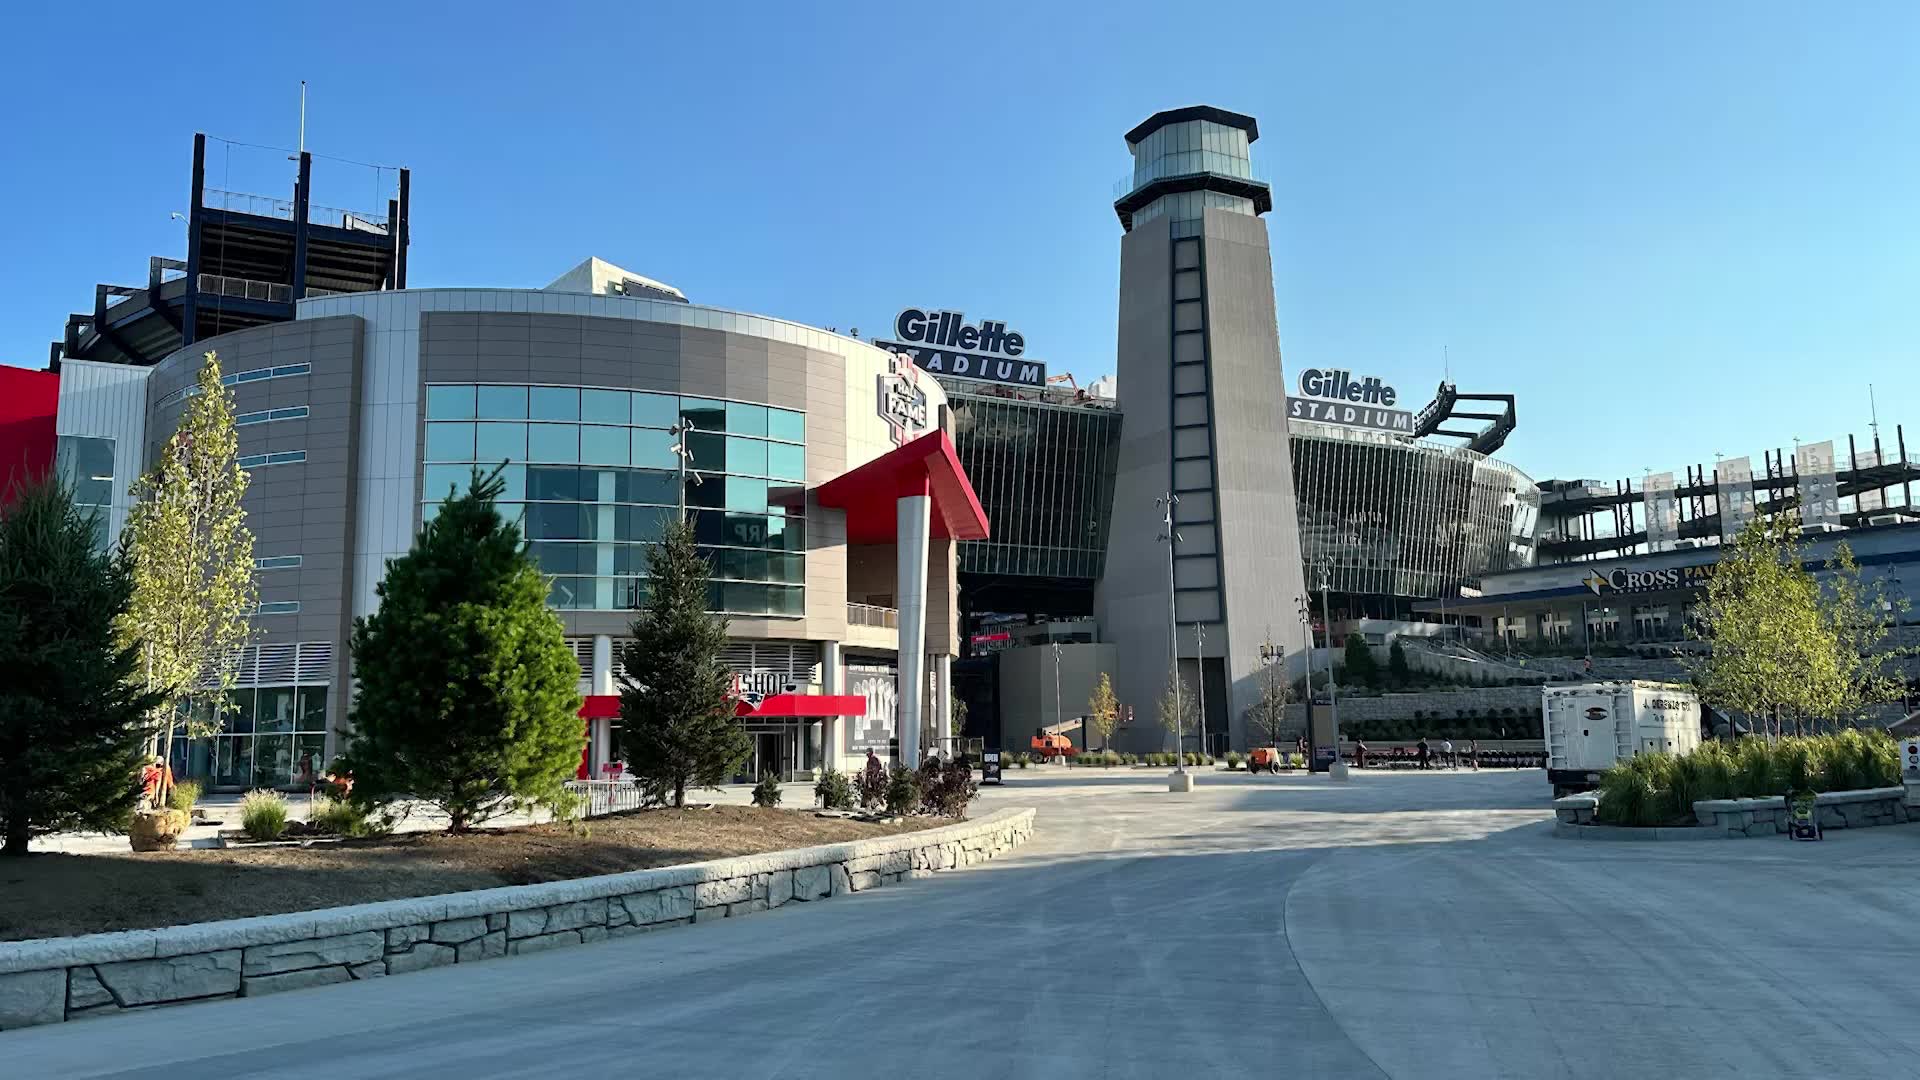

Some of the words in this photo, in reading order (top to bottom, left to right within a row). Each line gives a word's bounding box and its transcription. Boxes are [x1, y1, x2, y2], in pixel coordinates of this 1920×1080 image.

[898, 309, 1024, 356] Gillette
[1302, 368, 1396, 407] Gillette
[888, 392, 925, 426] FAME
[1292, 400, 1408, 428] STADIUM
[1608, 569, 1679, 589] CROSS
